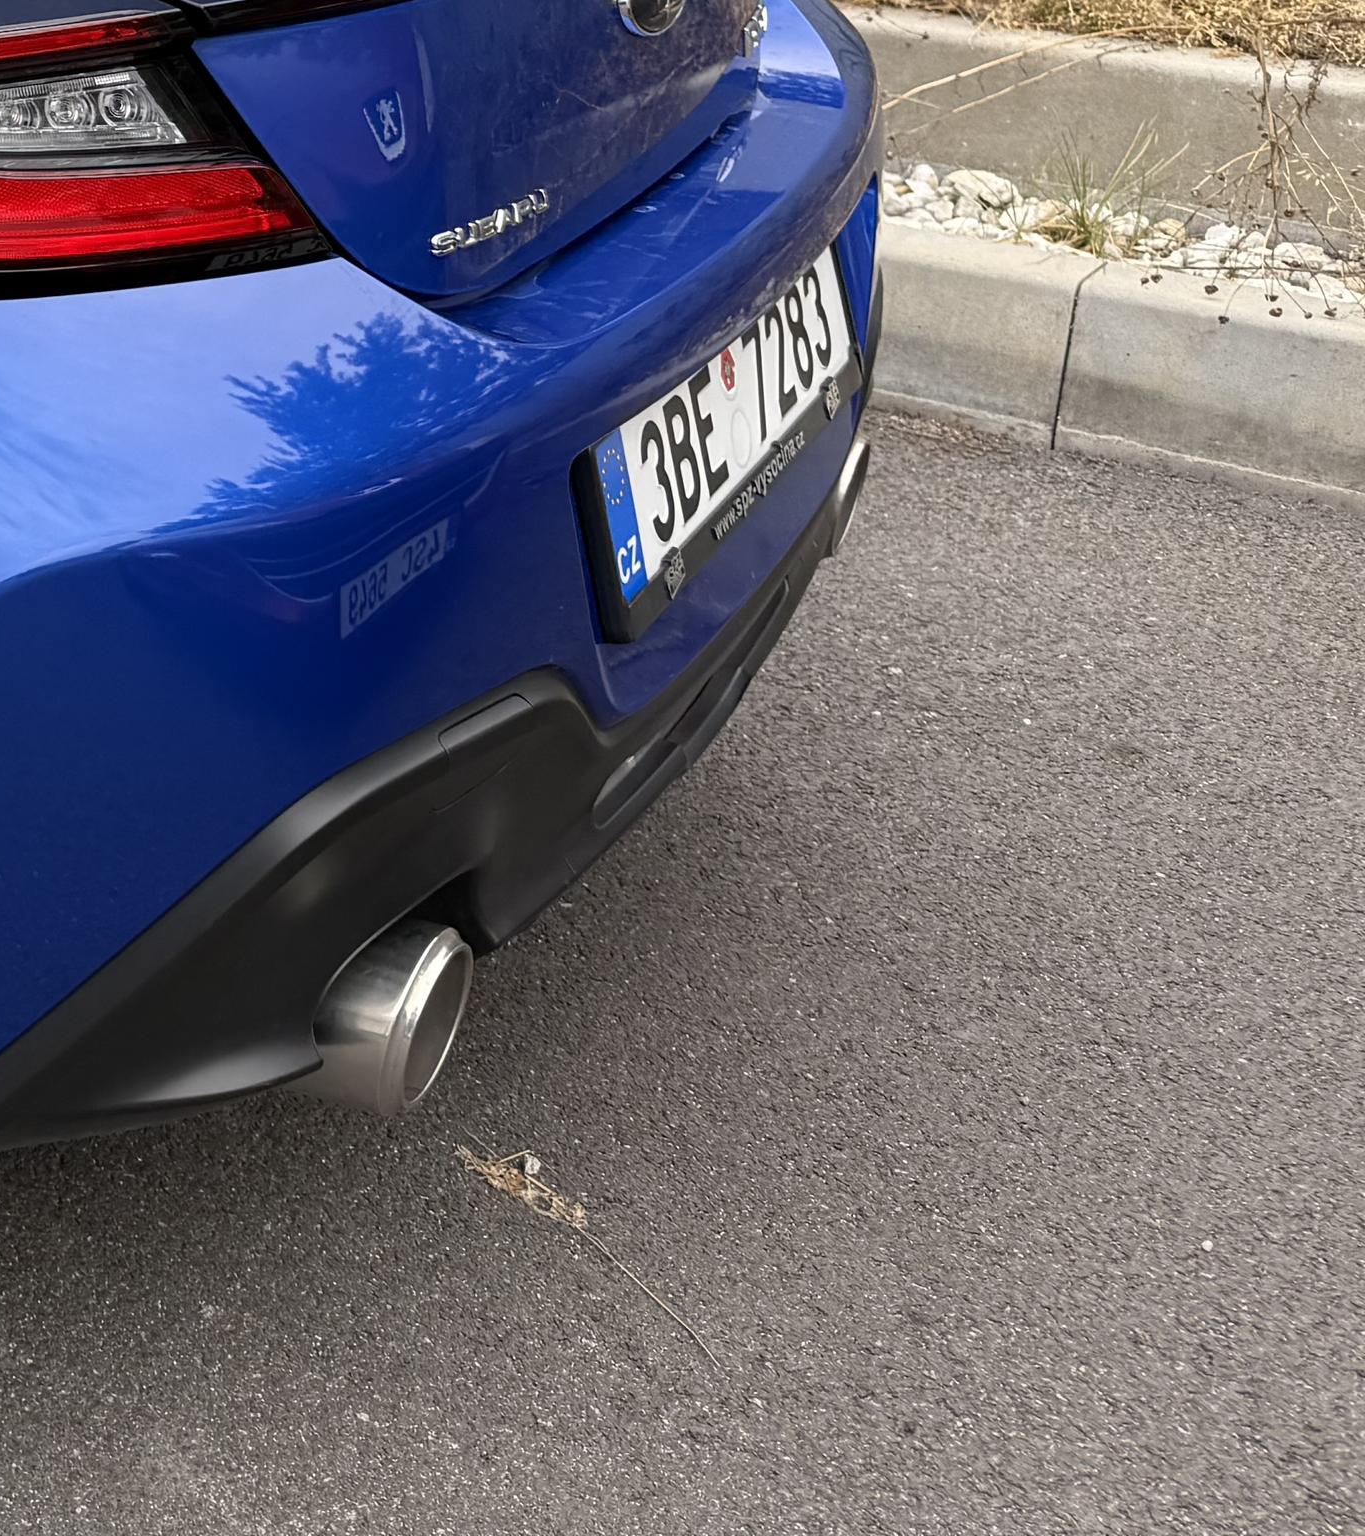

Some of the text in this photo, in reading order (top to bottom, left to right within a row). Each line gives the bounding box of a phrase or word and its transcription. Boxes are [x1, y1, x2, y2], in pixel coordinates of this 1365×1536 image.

[429, 188, 548, 257] SUBARU
[639, 264, 832, 544] 3BE 7283
[617, 534, 641, 585] CZ
